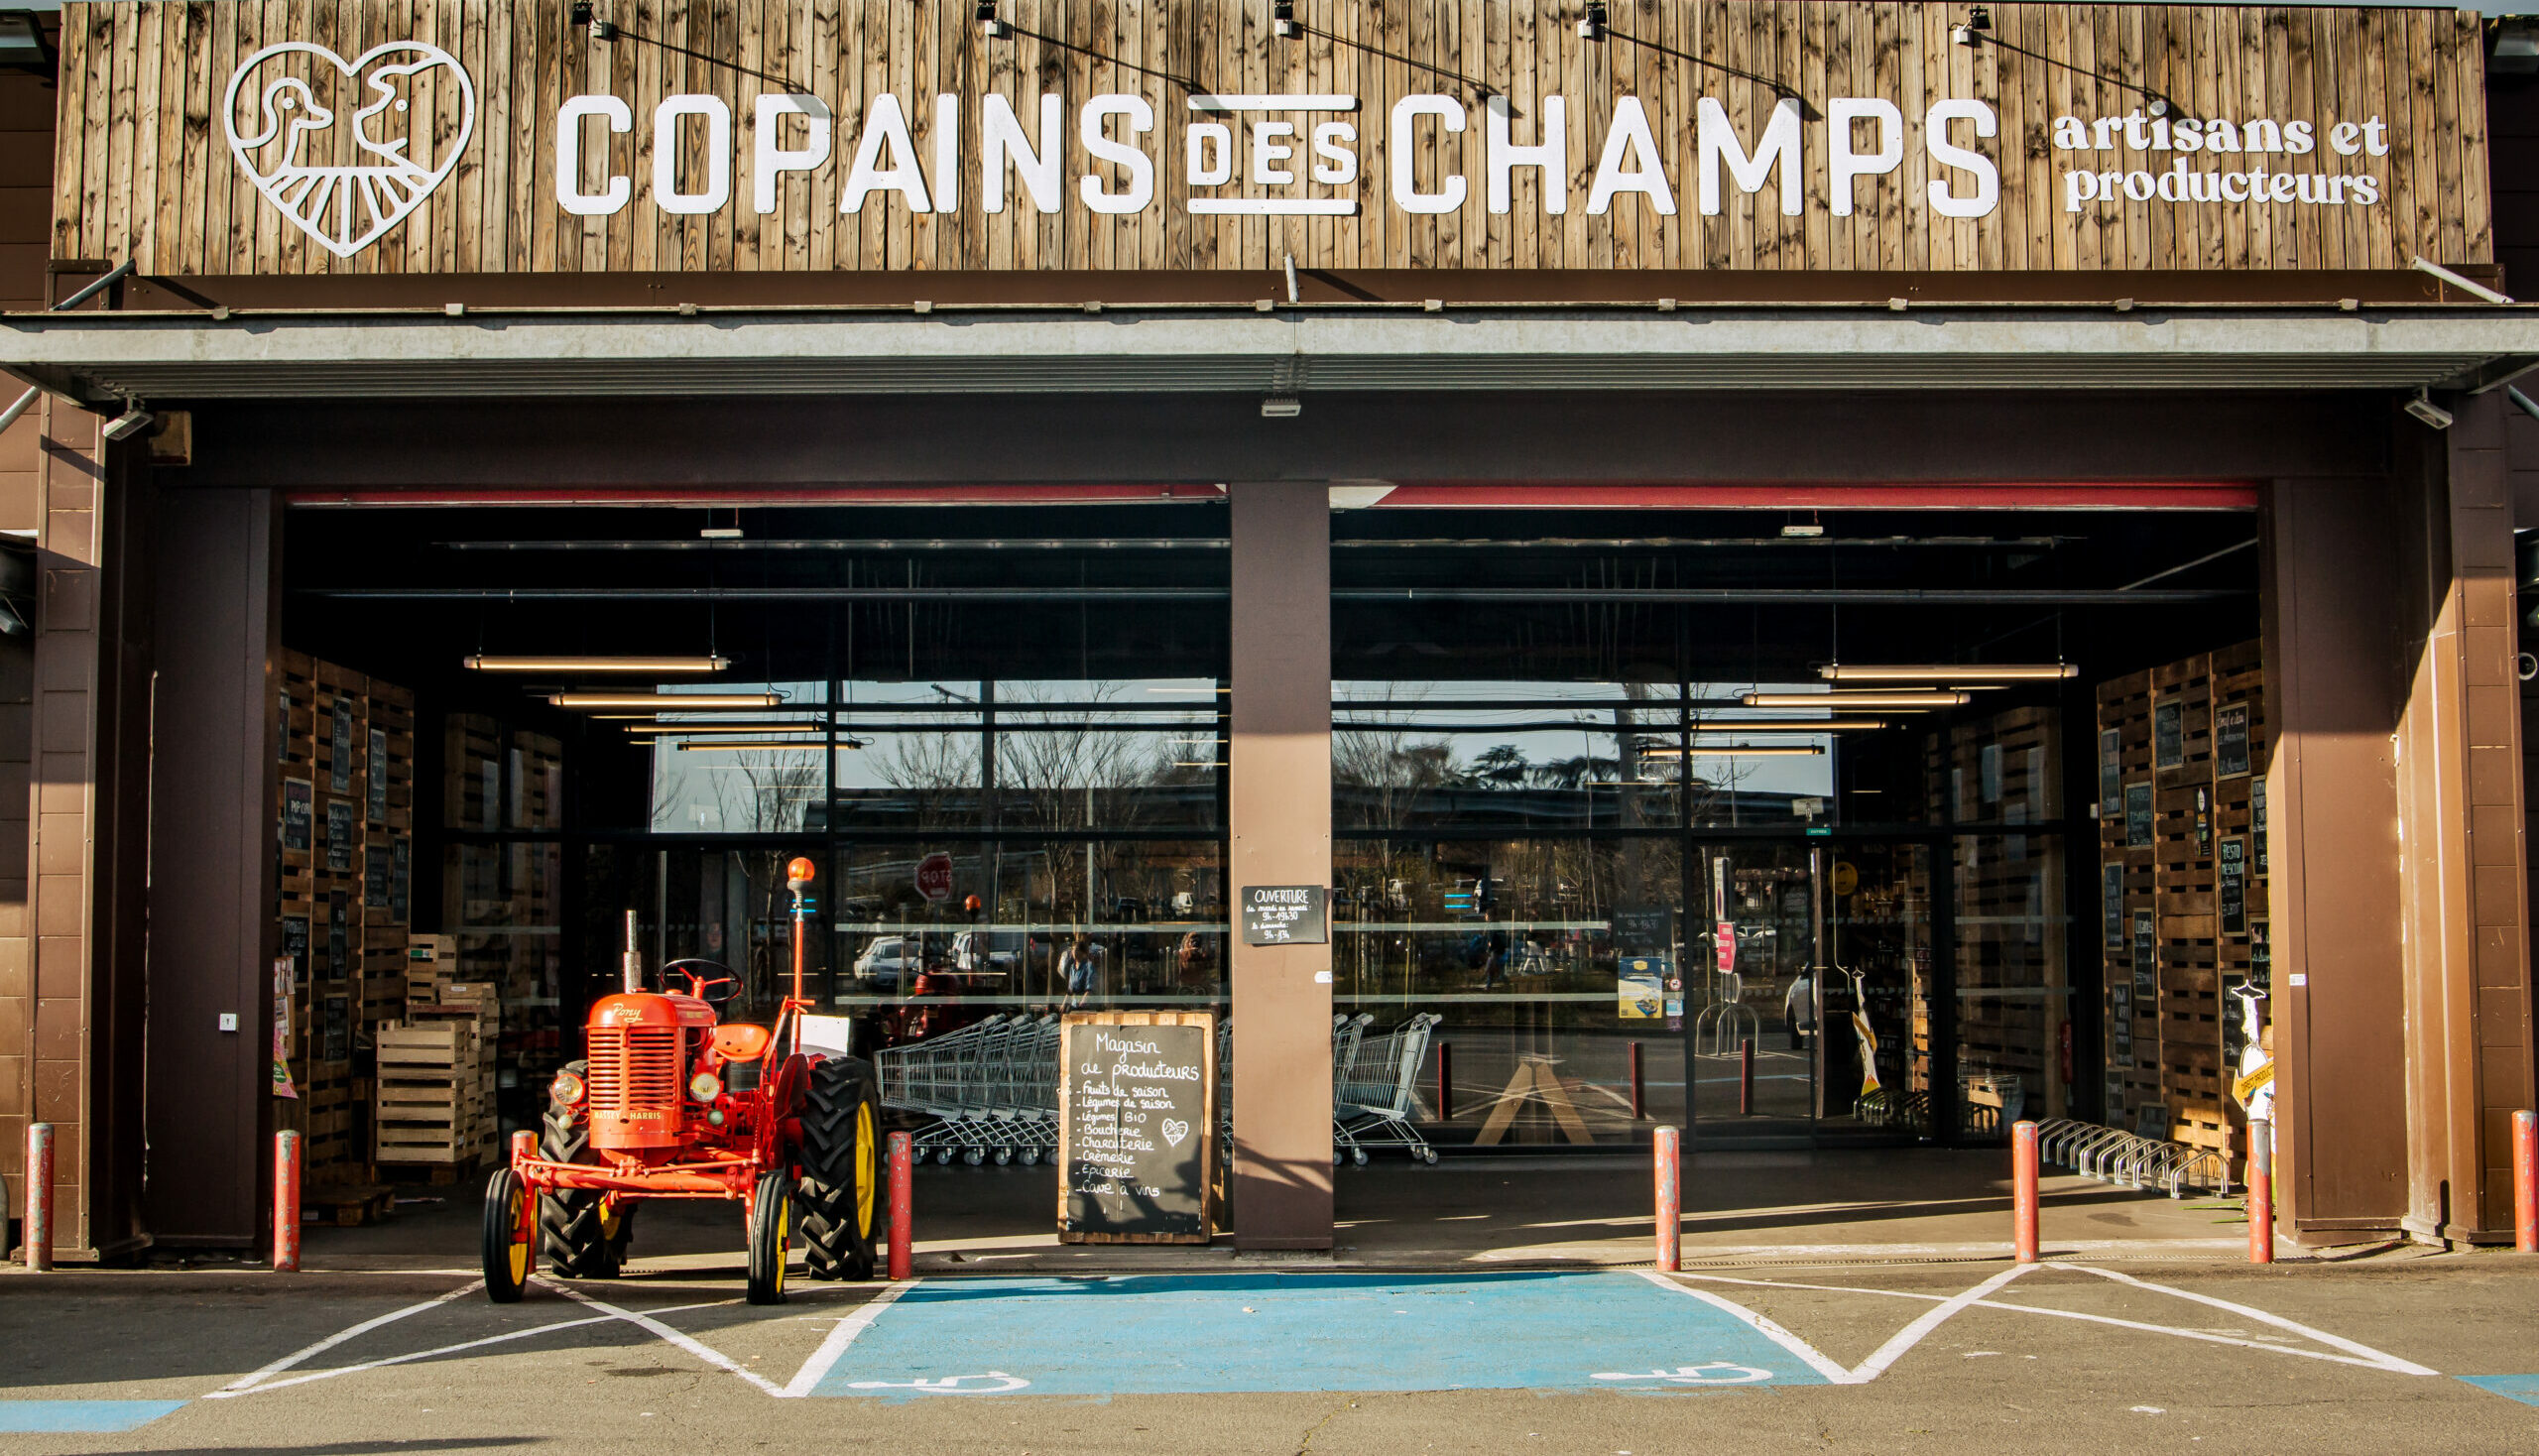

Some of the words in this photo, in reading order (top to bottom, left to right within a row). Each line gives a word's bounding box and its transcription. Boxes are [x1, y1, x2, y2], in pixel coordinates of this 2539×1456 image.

[2053, 100, 2316, 155] artisans
[2331, 115, 2389, 157] et
[555, 93, 1154, 215] COPAINS
[1187, 121, 1358, 186] DES
[1390, 93, 2000, 218] CHAMPS
[2064, 156, 2379, 212] producteurs
[1254, 889, 1309, 905] OUVERTURE
[613, 1003, 643, 1023] Pony
[1096, 1031, 1161, 1064] Magasin
[1113, 1085, 1129, 1097] de
[1132, 1085, 1169, 1098] saison
[1124, 1098, 1137, 1108] de
[1140, 1098, 1175, 1110] saison
[1120, 1180, 1129, 1196] à
[1136, 1184, 1160, 1197] vins
